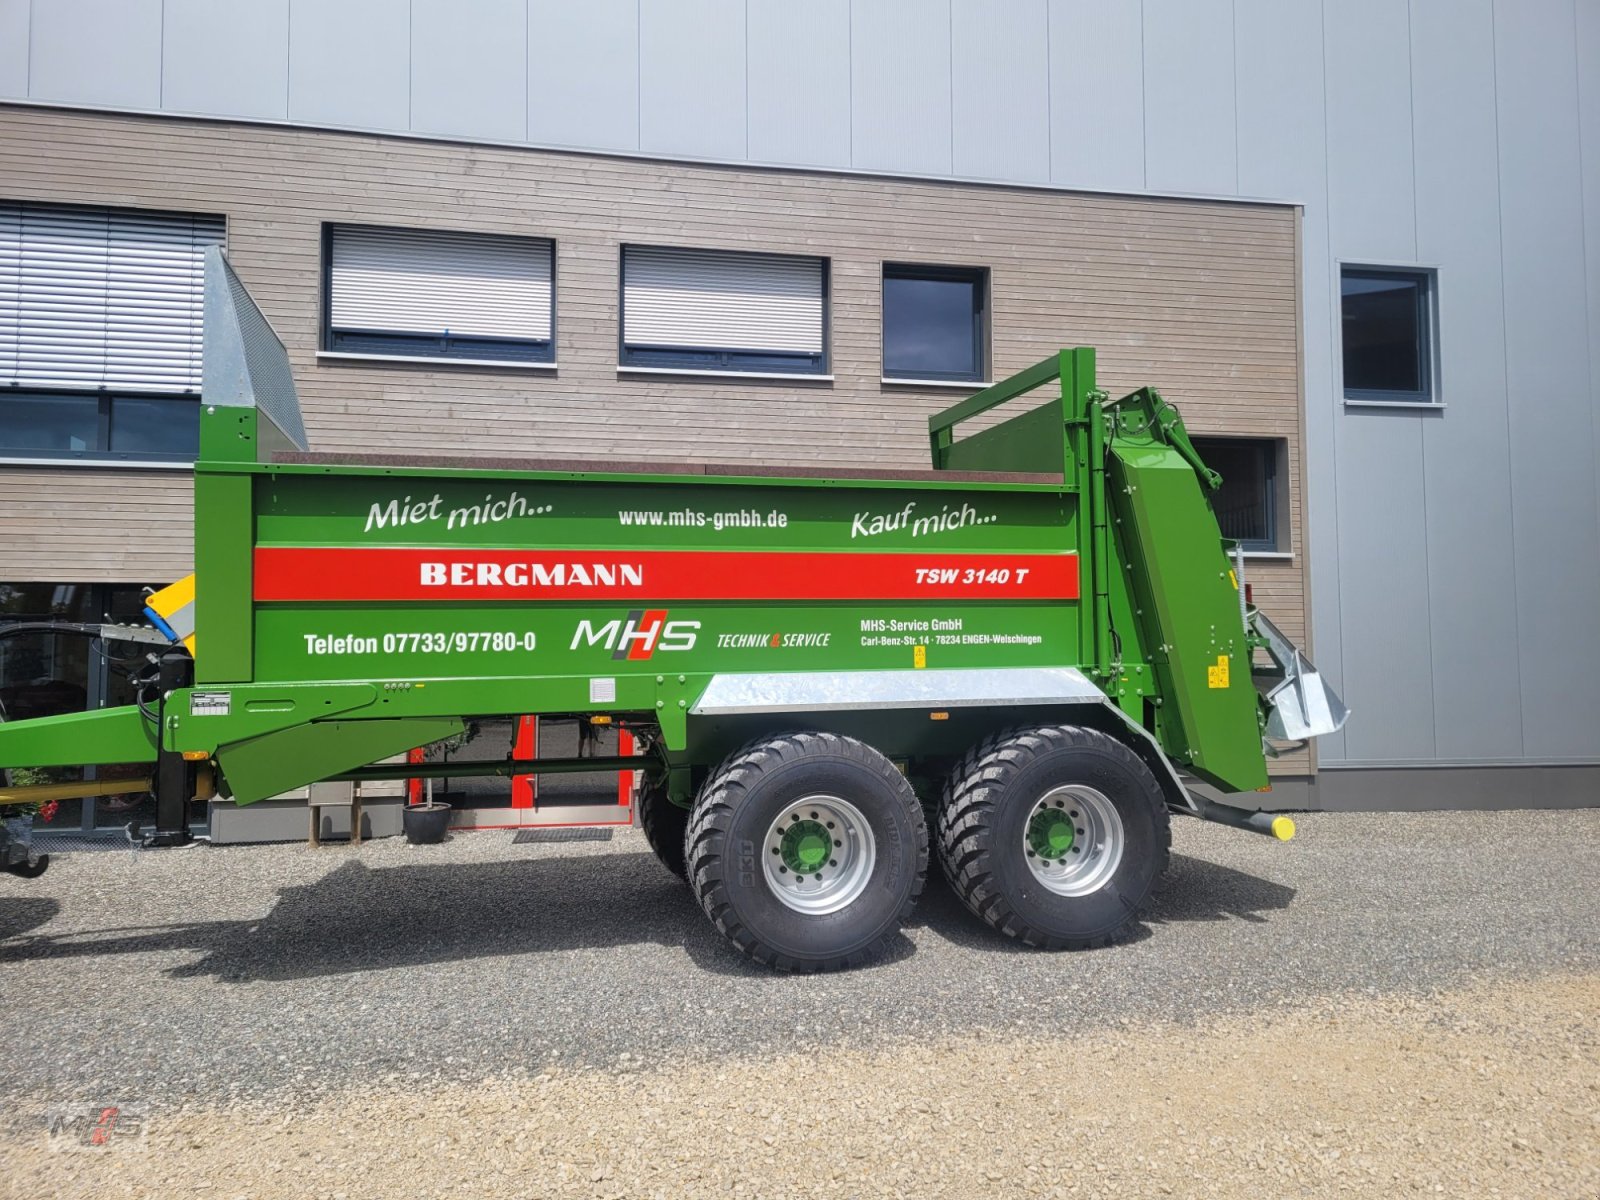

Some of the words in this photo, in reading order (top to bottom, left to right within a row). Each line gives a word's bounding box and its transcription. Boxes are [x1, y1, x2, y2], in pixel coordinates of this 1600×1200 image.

[364, 494, 443, 532] Miet
[446, 491, 553, 531] mich...
[618, 508, 788, 531] www.mhs-gmbh.de
[851, 501, 917, 539] Kauf
[911, 502, 998, 538] mich...
[420, 562, 643, 587] BERGMANN
[915, 568, 960, 585] TSW
[962, 568, 1010, 585] 3140
[1015, 568, 1030, 585] T
[569, 618, 702, 652] MHS
[860, 618, 929, 632] MHS-Service
[931, 618, 963, 632] GmbH
[303, 633, 378, 655] Telefon
[382, 631, 537, 655] 07733/97780-0
[717, 633, 770, 648] TECHNIK
[781, 632, 832, 647] SERVICE
[860, 635, 917, 647] Carl-Benz-Str.
[919, 635, 930, 646] 14
[935, 635, 961, 646] 78234
[962, 633, 1042, 647] ENGEN-Welschingen
